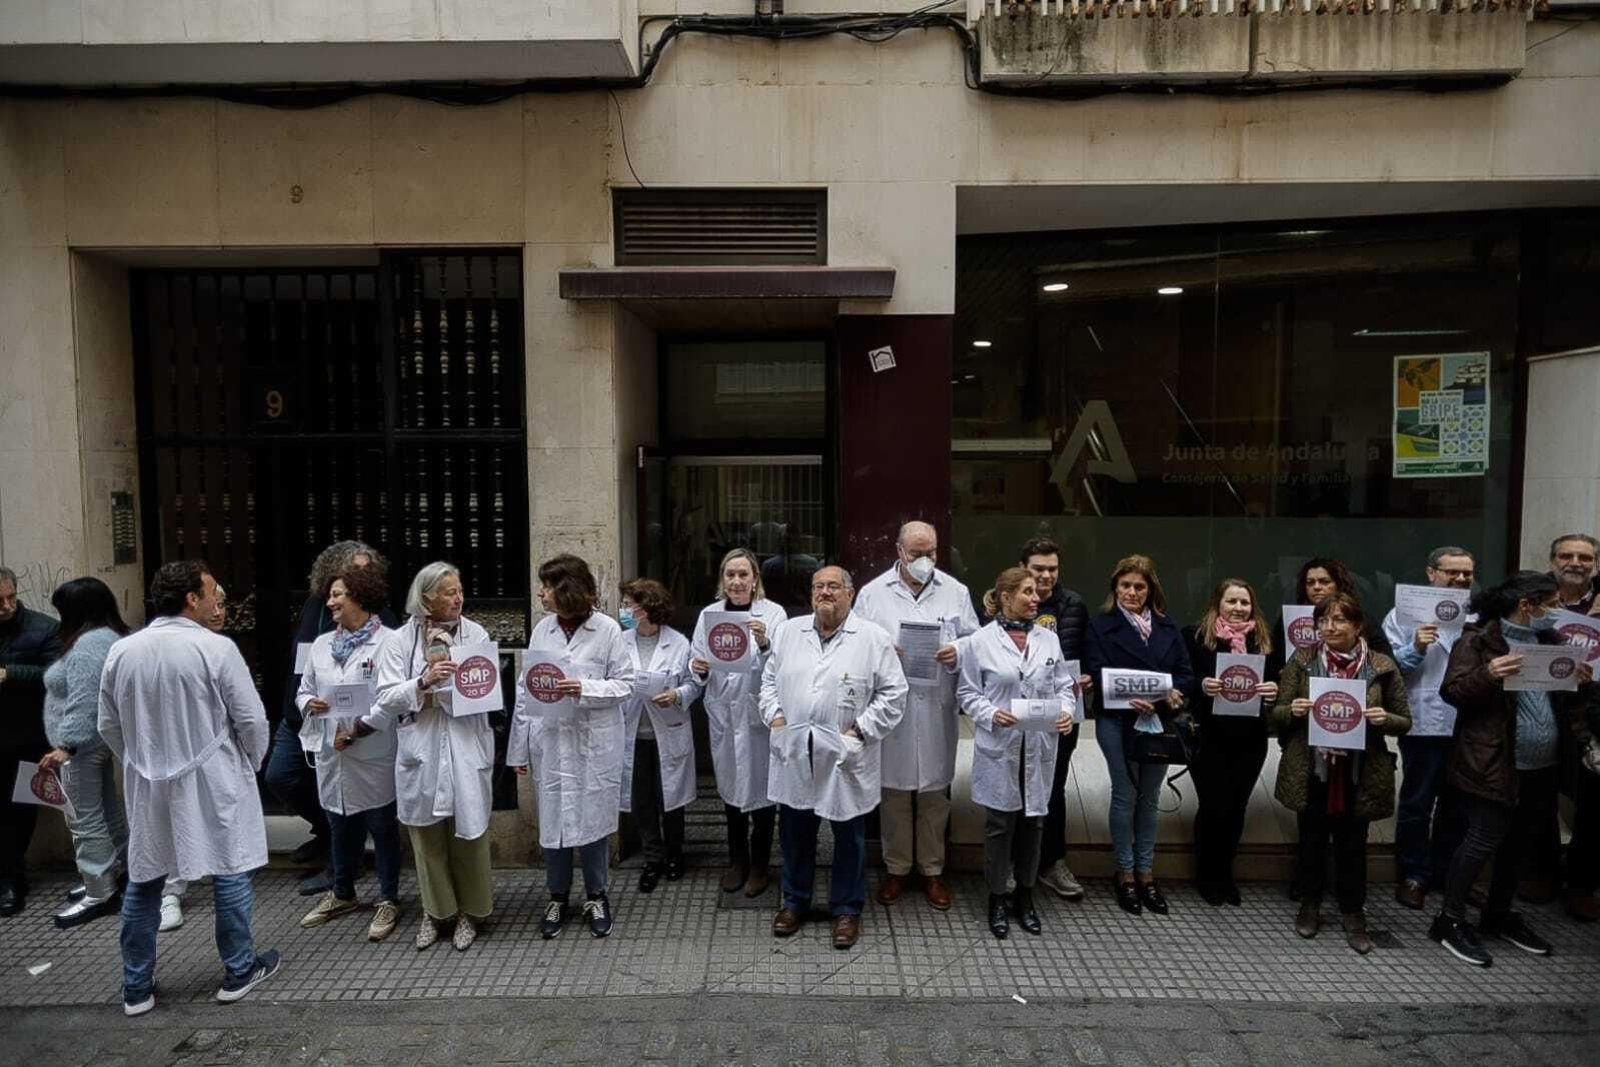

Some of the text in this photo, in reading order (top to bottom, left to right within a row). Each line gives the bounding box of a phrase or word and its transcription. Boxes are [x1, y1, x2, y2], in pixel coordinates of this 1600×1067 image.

[290, 184, 304, 204] 9
[265, 390, 283, 418] 9
[1421, 404, 1459, 417] GRIPE
[1162, 441, 1378, 461] Junta de Andalua
[713, 635, 741, 648] SMP
[460, 668, 490, 685] SMP
[1224, 676, 1254, 690] SMP
[1114, 677, 1160, 693] SMP
[466, 688, 478, 697] 20
[538, 692, 550, 701] 20
[1320, 704, 1354, 719] SMP
[1324, 722, 1338, 731] 20
